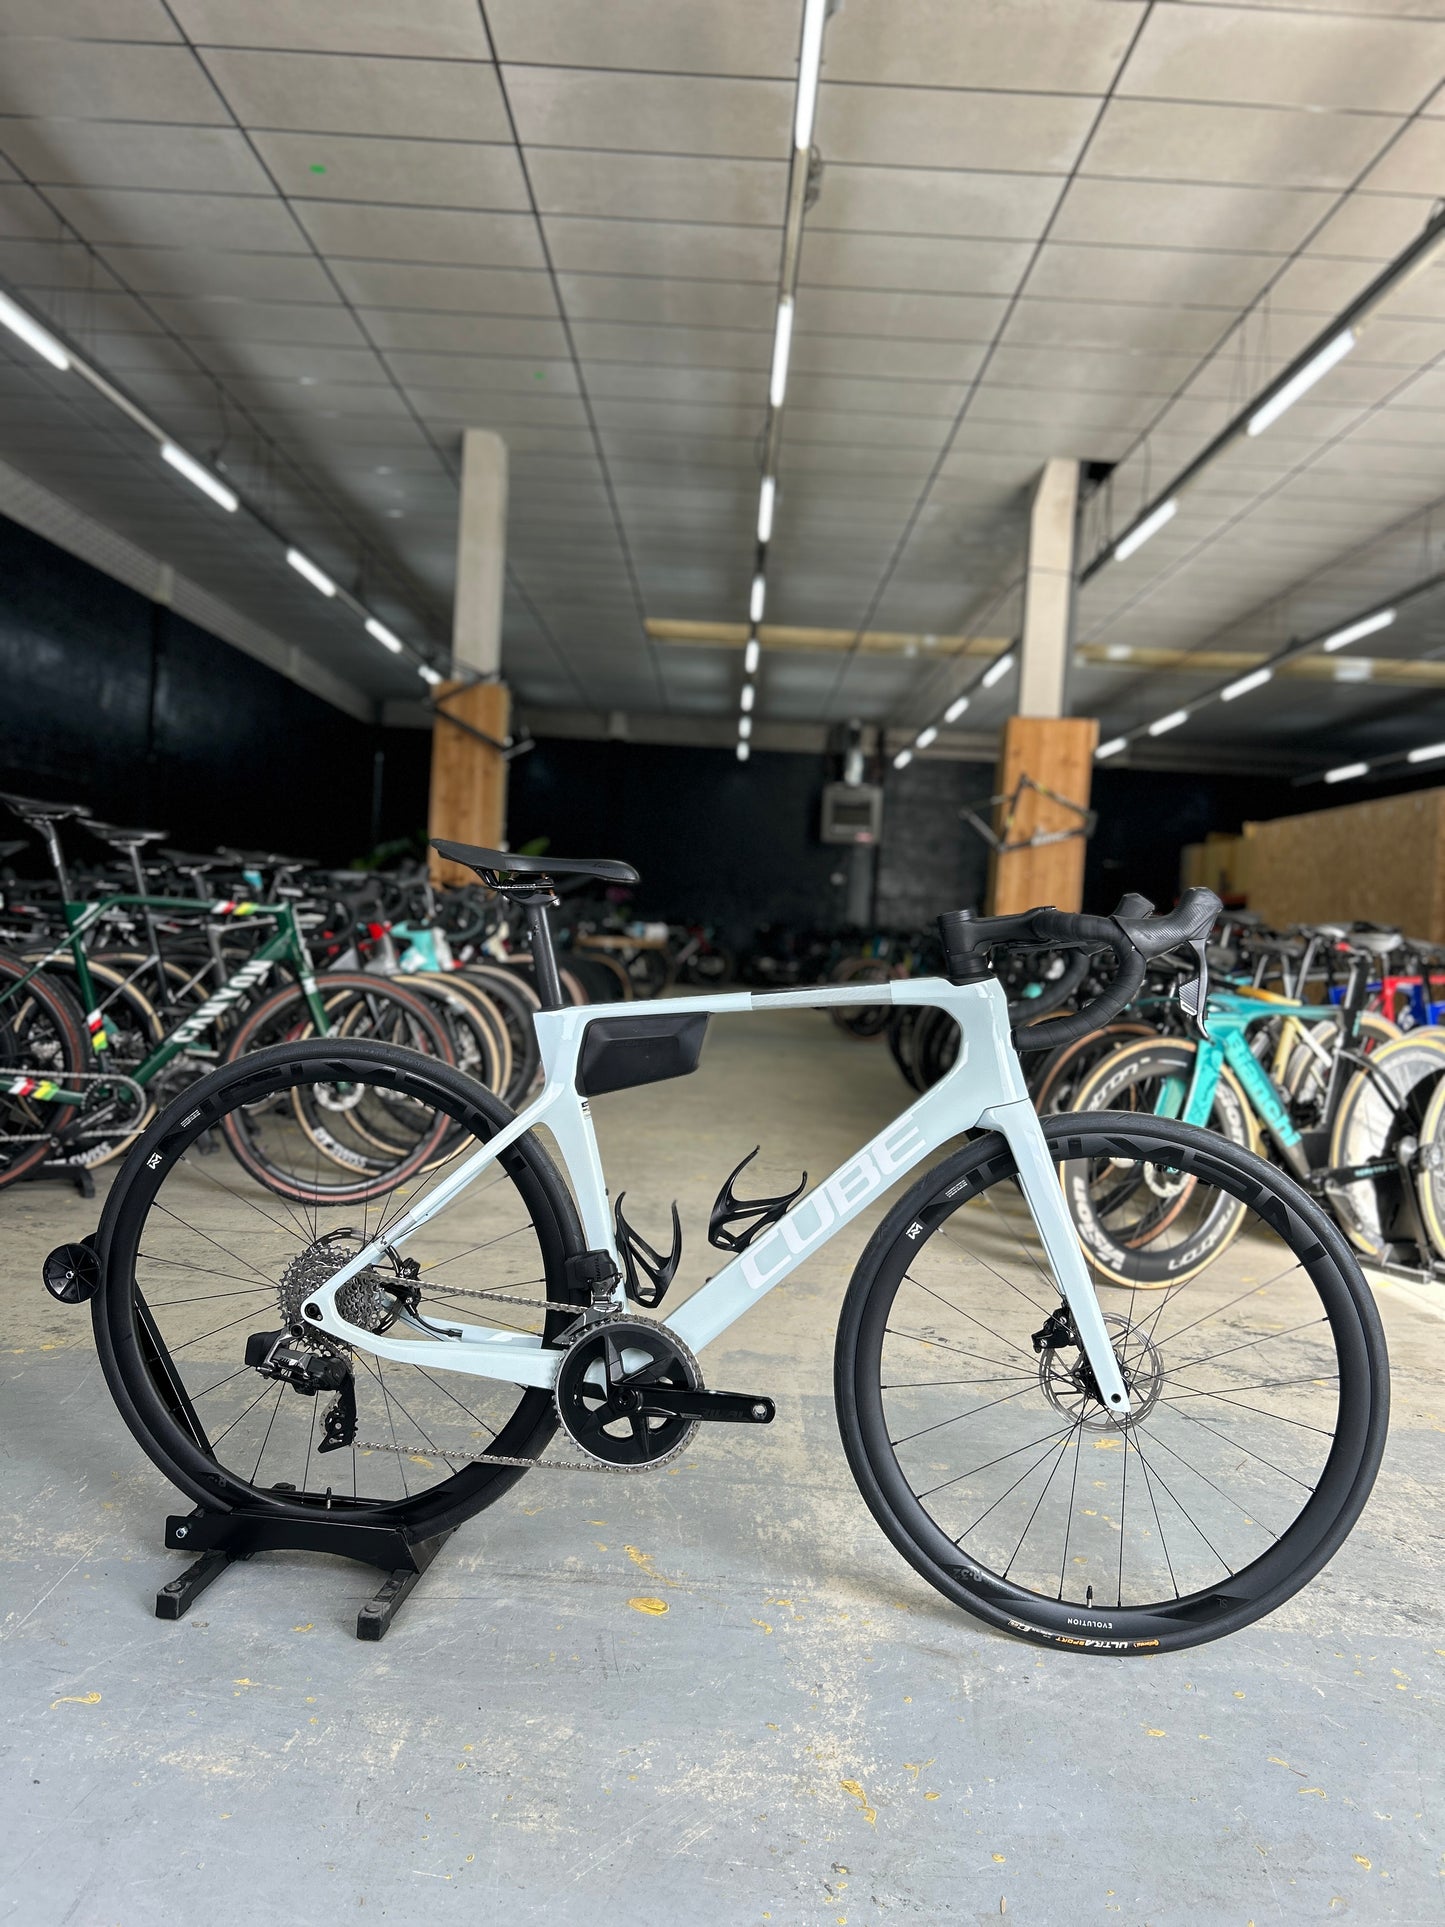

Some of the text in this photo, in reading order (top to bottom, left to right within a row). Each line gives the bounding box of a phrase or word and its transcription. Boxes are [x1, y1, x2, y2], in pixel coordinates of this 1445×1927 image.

[171, 959, 274, 1043] CANYON
[1224, 1030, 1303, 1147] Bianchi
[739, 1113, 927, 1290] CUBE
[1055, 1635, 1086, 1646] SPORT
[1066, 1617, 1113, 1630] EVOLUTION
[1084, 1639, 1129, 1649] ULTRA
